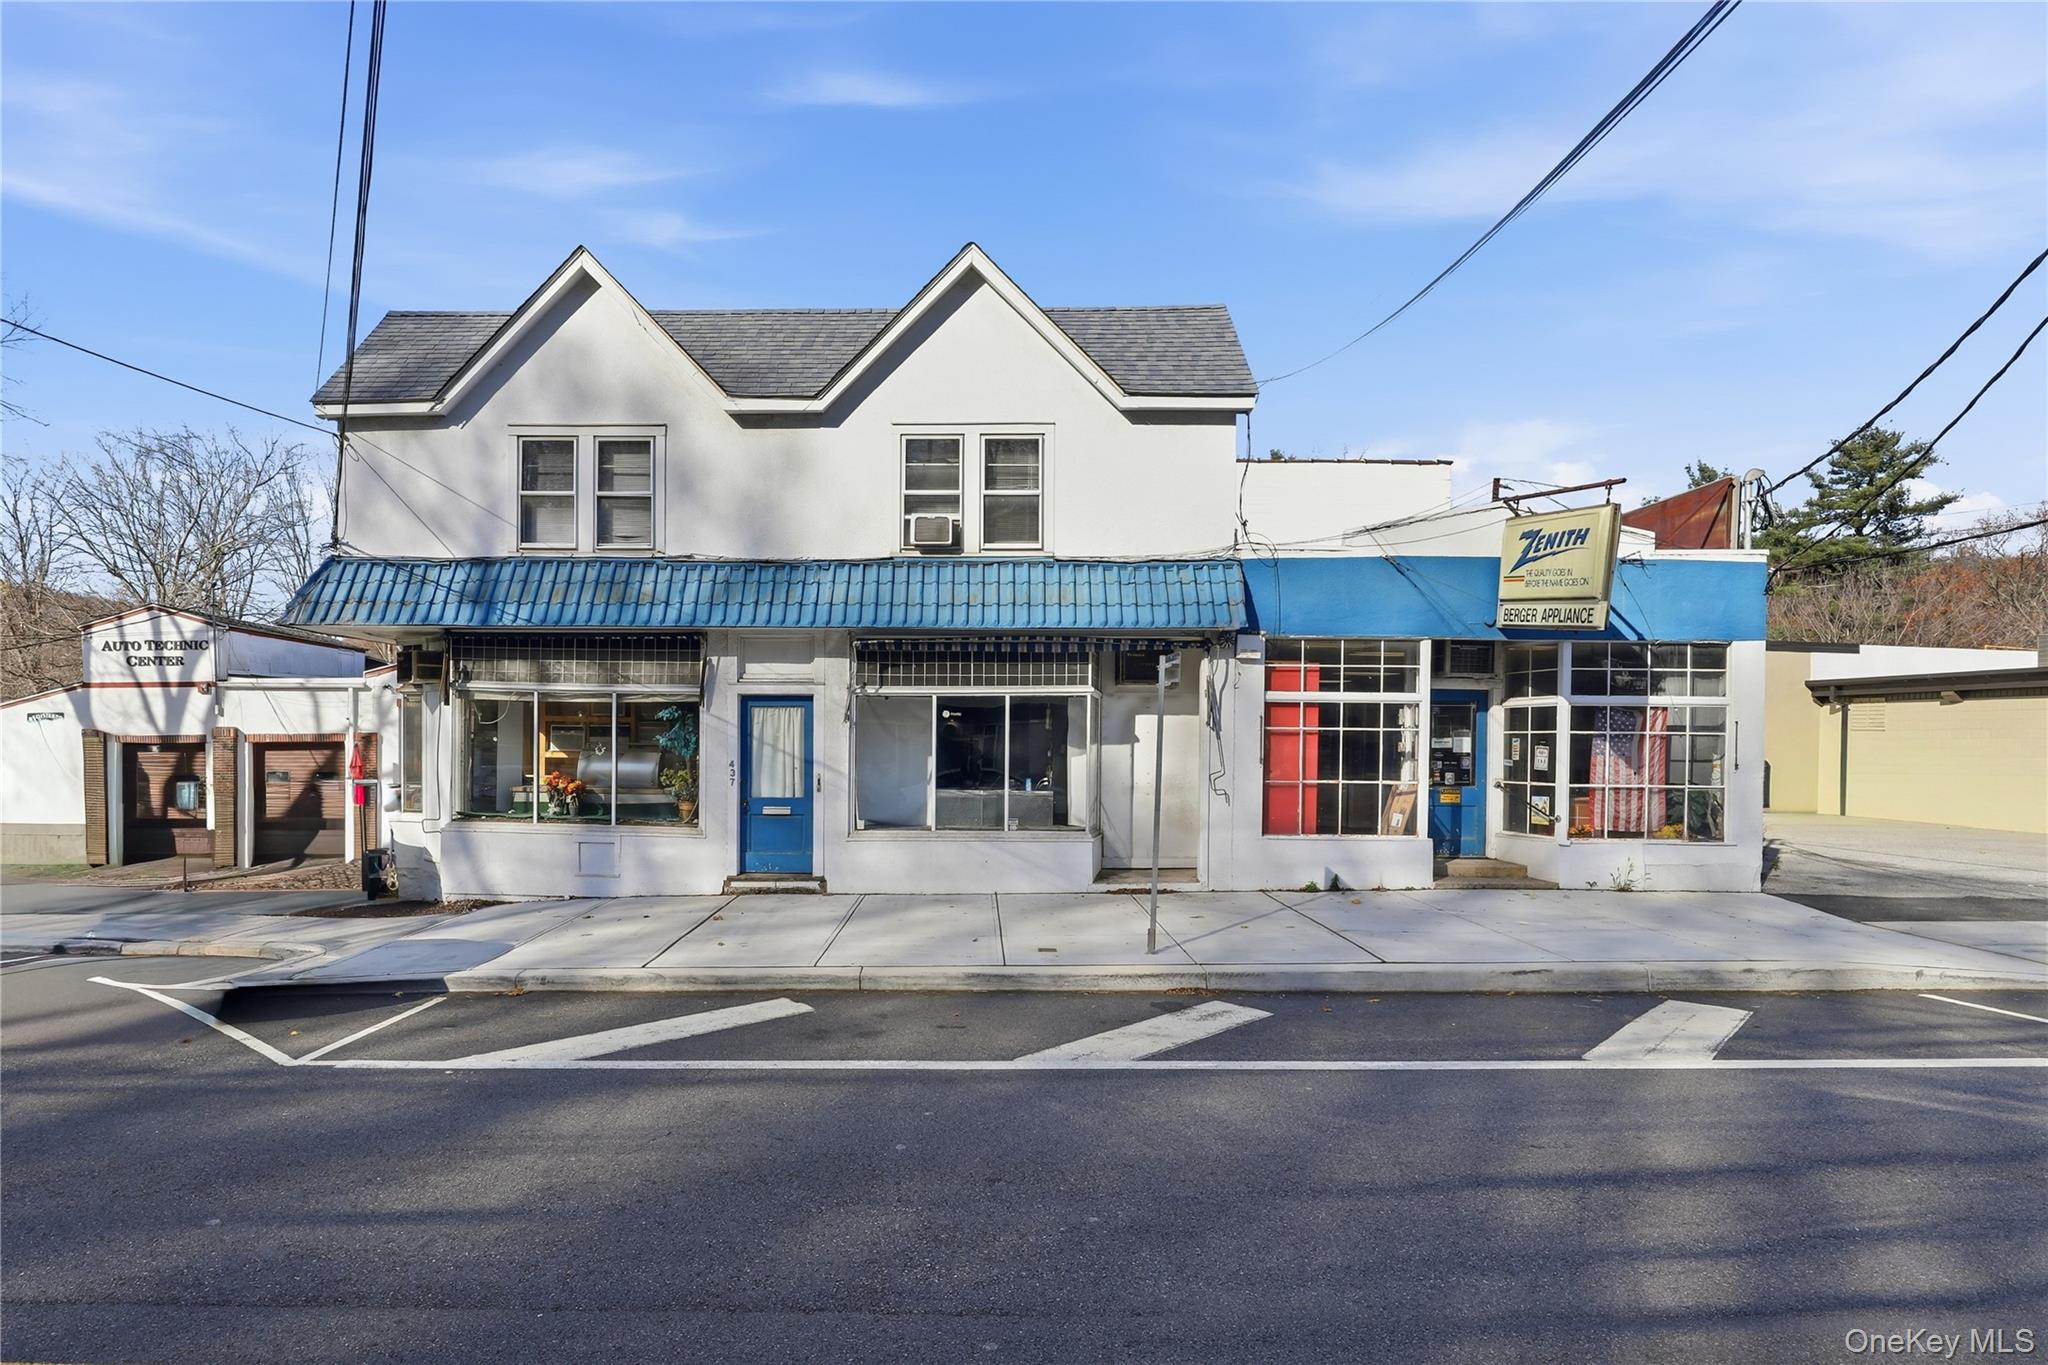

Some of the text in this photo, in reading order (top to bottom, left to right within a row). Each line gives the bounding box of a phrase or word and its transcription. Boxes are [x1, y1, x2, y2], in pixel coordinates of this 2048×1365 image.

[1508, 527, 1591, 574] ZENITH
[1503, 607, 1595, 624] BERGER APPLIANCE
[101, 639, 209, 652] AUTO TECHNIC
[126, 655, 185, 667] CENTER
